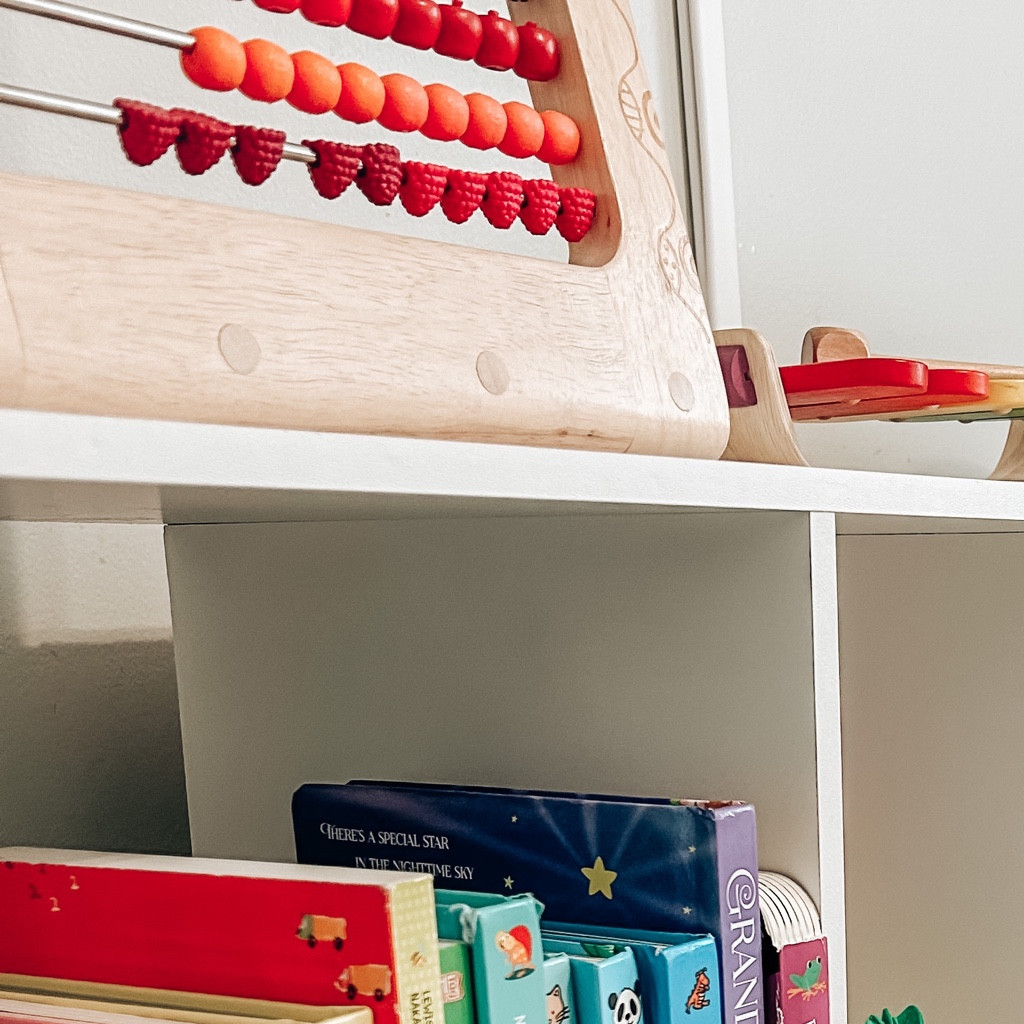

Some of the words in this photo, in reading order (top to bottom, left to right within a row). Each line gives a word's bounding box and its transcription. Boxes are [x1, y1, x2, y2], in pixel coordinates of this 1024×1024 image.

[320, 822, 366, 843] THERE'S
[369, 830, 377, 844] A
[378, 831, 421, 848] SPECIAL
[423, 834, 450, 850] STAR
[355, 857, 367, 869] IN
[368, 857, 390, 871] THE
[393, 860, 452, 878] NIGHTTIME
[454, 865, 475, 880] SKY
